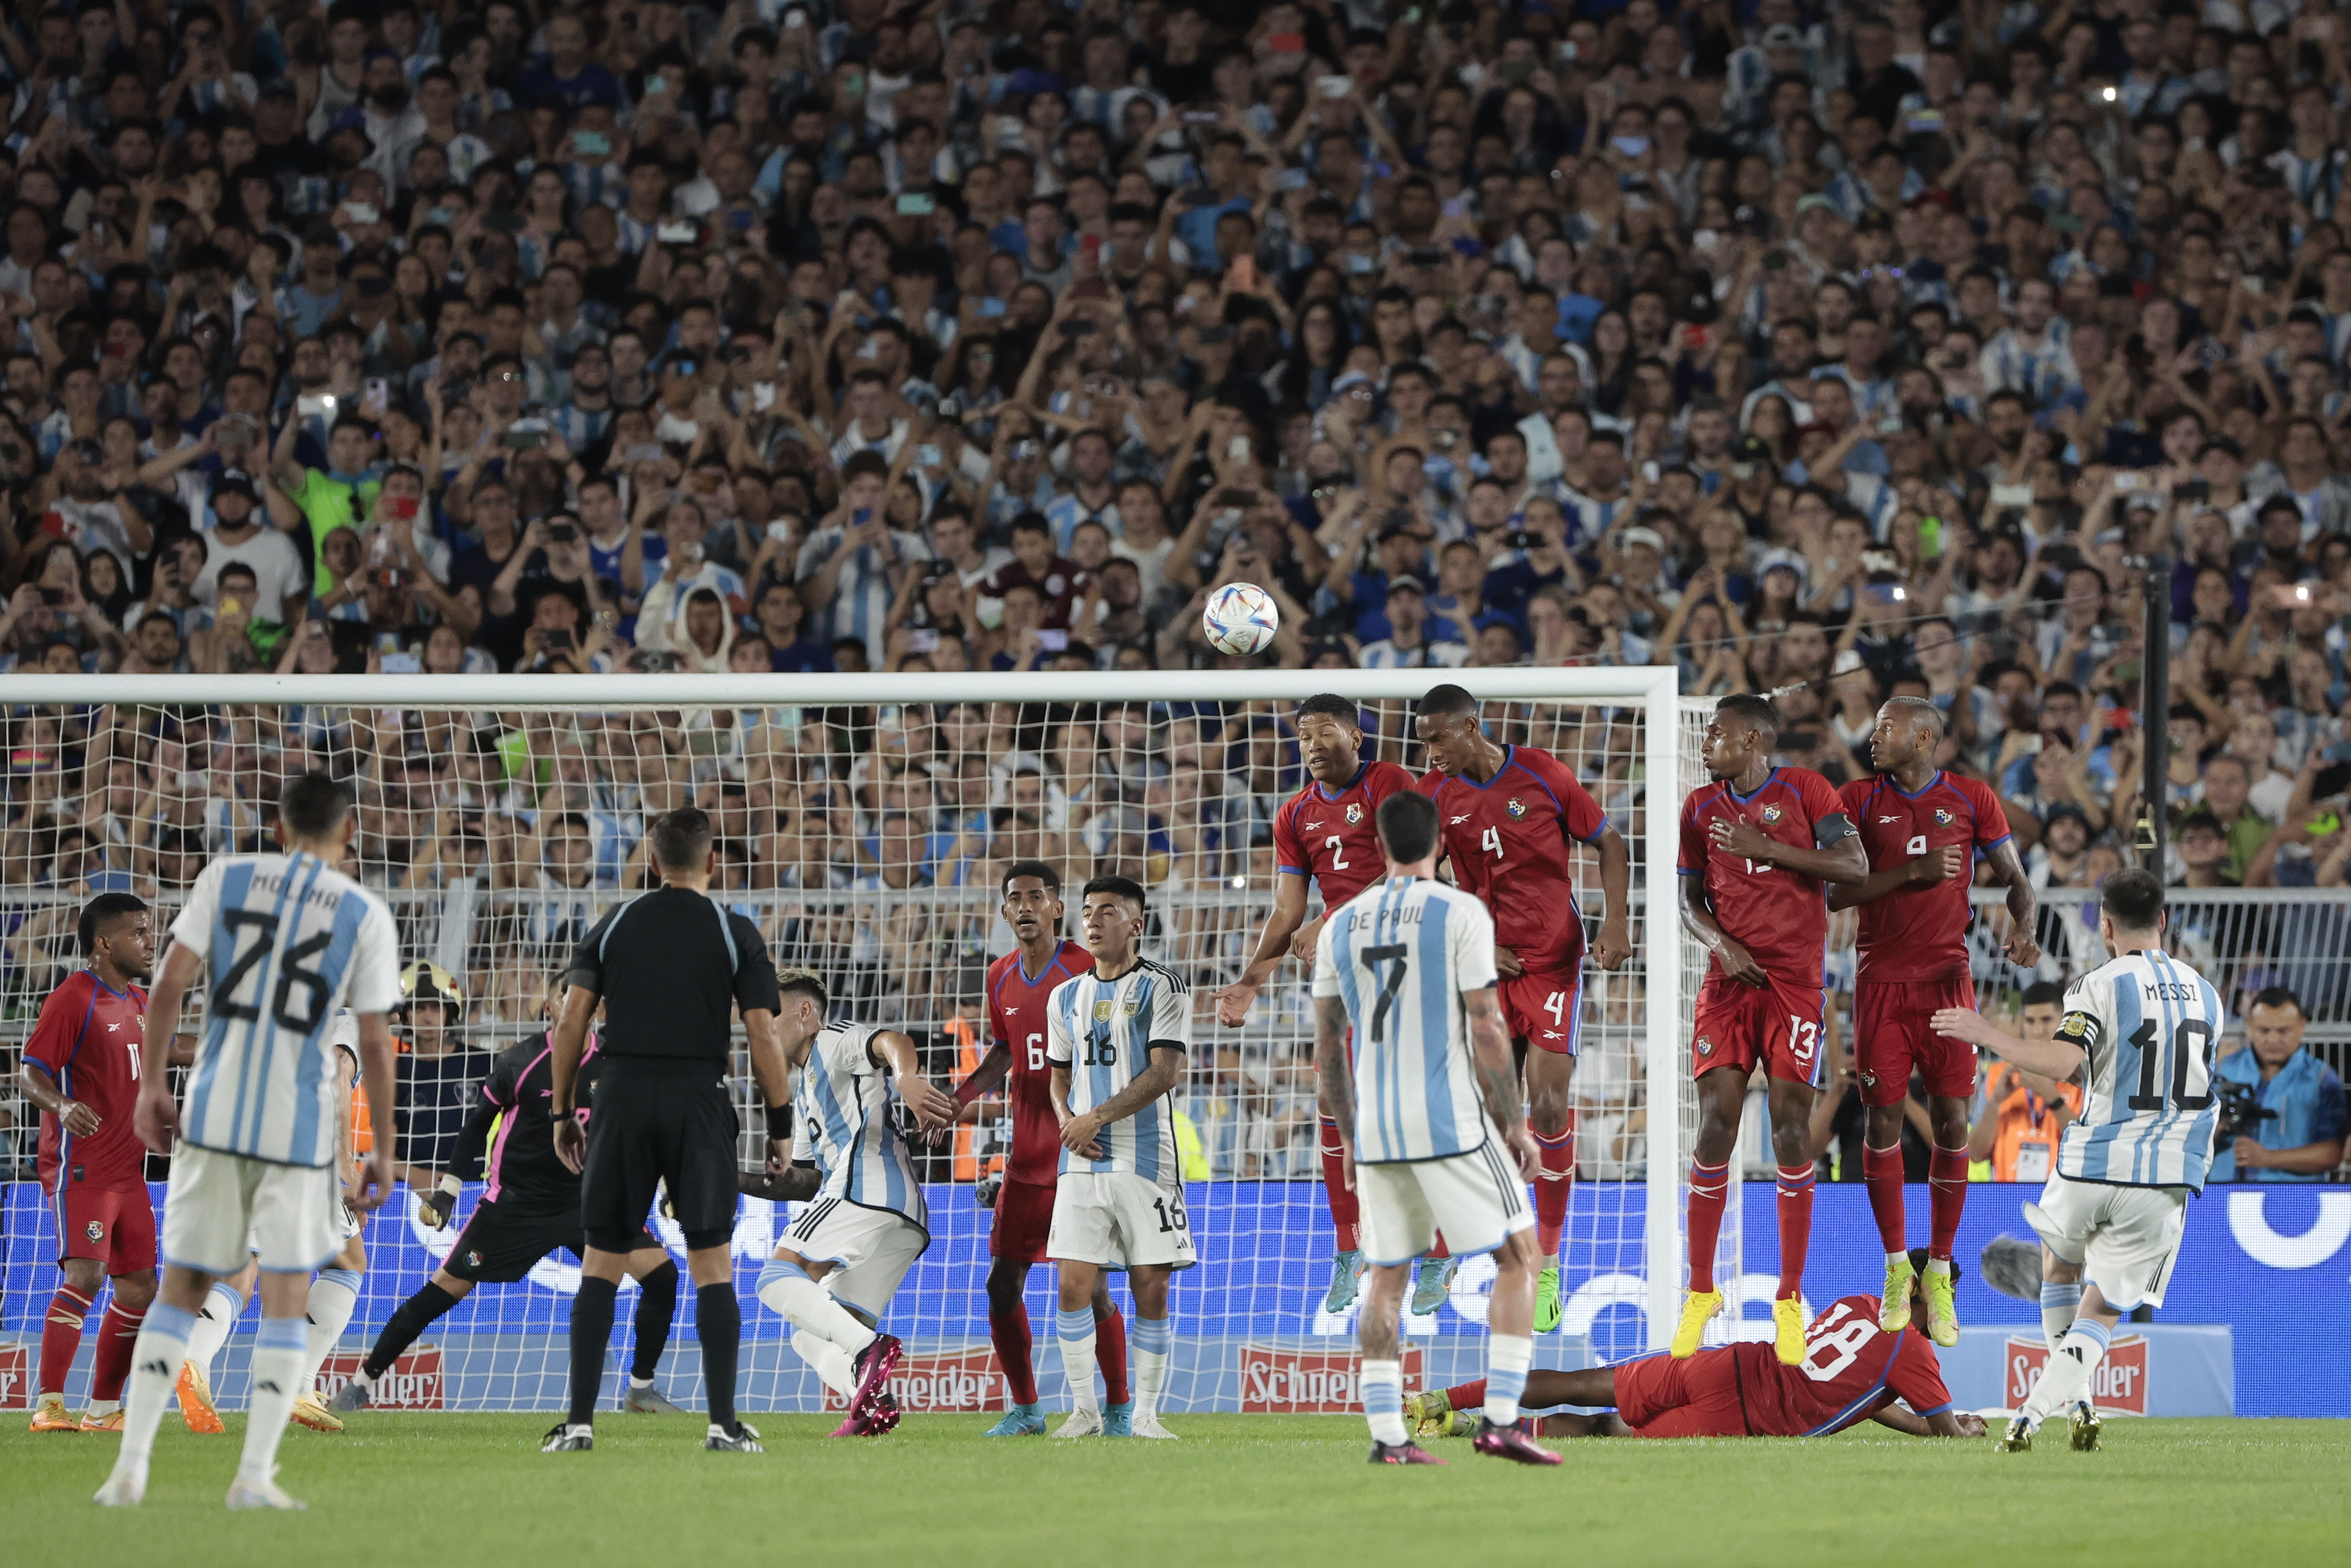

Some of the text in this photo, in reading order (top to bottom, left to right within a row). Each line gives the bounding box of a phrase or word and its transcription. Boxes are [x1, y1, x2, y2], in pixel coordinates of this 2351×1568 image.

[1325, 835, 1349, 871] 2
[1482, 825, 1504, 859] 4
[1348, 906, 1423, 934] DE PAUL
[212, 906, 334, 1037] 26
[1360, 942, 1407, 1043] 7
[1543, 991, 1565, 1026] 4
[2144, 983, 2198, 1002] MESSI
[1026, 1033, 1045, 1071] 6
[1084, 1030, 1117, 1066] 16
[1789, 1014, 1817, 1060] 13
[2128, 1018, 2215, 1111] 10
[1153, 1195, 1187, 1233] 16
[1799, 1302, 1880, 1382] 18
